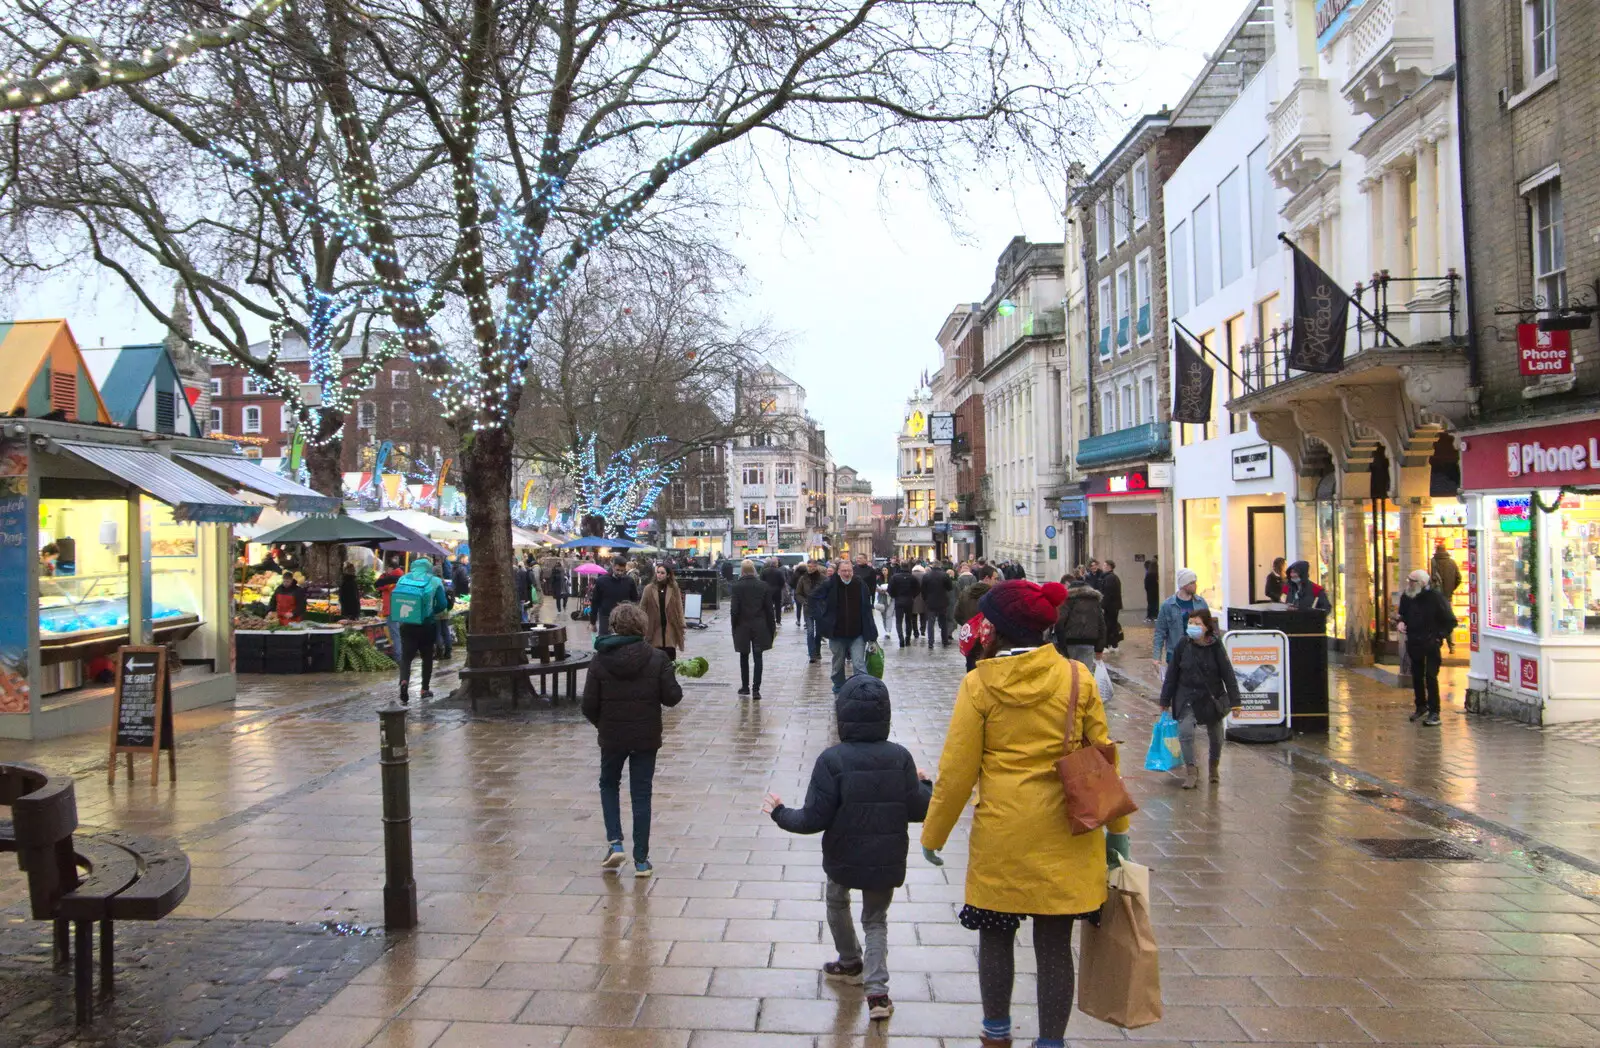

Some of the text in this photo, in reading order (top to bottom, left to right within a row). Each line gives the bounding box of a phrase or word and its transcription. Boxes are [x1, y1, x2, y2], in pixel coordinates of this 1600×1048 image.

[1311, 284, 1332, 361] Arcade
[1295, 315, 1315, 366] Royal
[1523, 349, 1567, 359] Phone
[1528, 359, 1562, 370] Land
[1187, 362, 1202, 416] Arcade
[1522, 441, 1587, 473] Phone
[897, 508, 928, 527] 250
